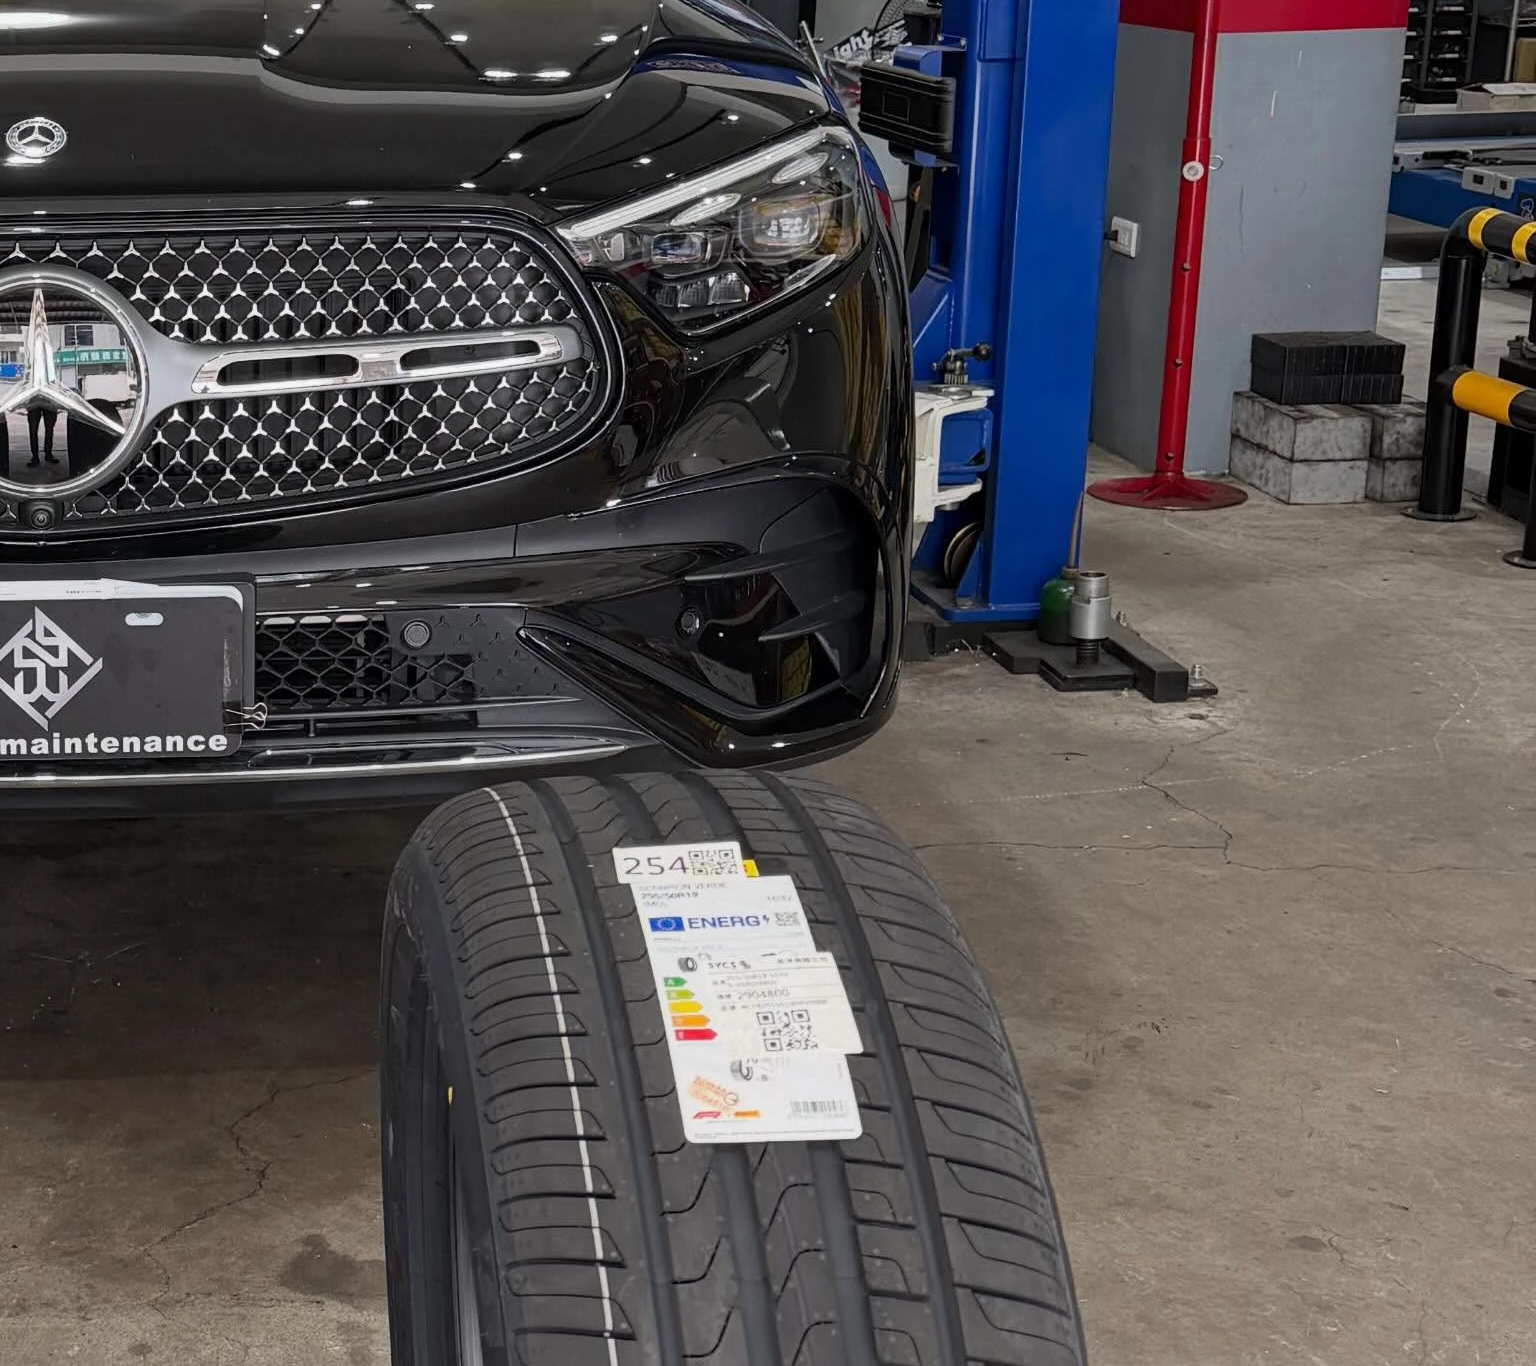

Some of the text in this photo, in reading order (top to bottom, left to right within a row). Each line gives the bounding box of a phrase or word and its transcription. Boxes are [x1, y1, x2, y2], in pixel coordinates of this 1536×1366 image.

[0, 732, 229, 756] maintenance
[622, 856, 688, 876] 254
[687, 914, 761, 930] ENERG
